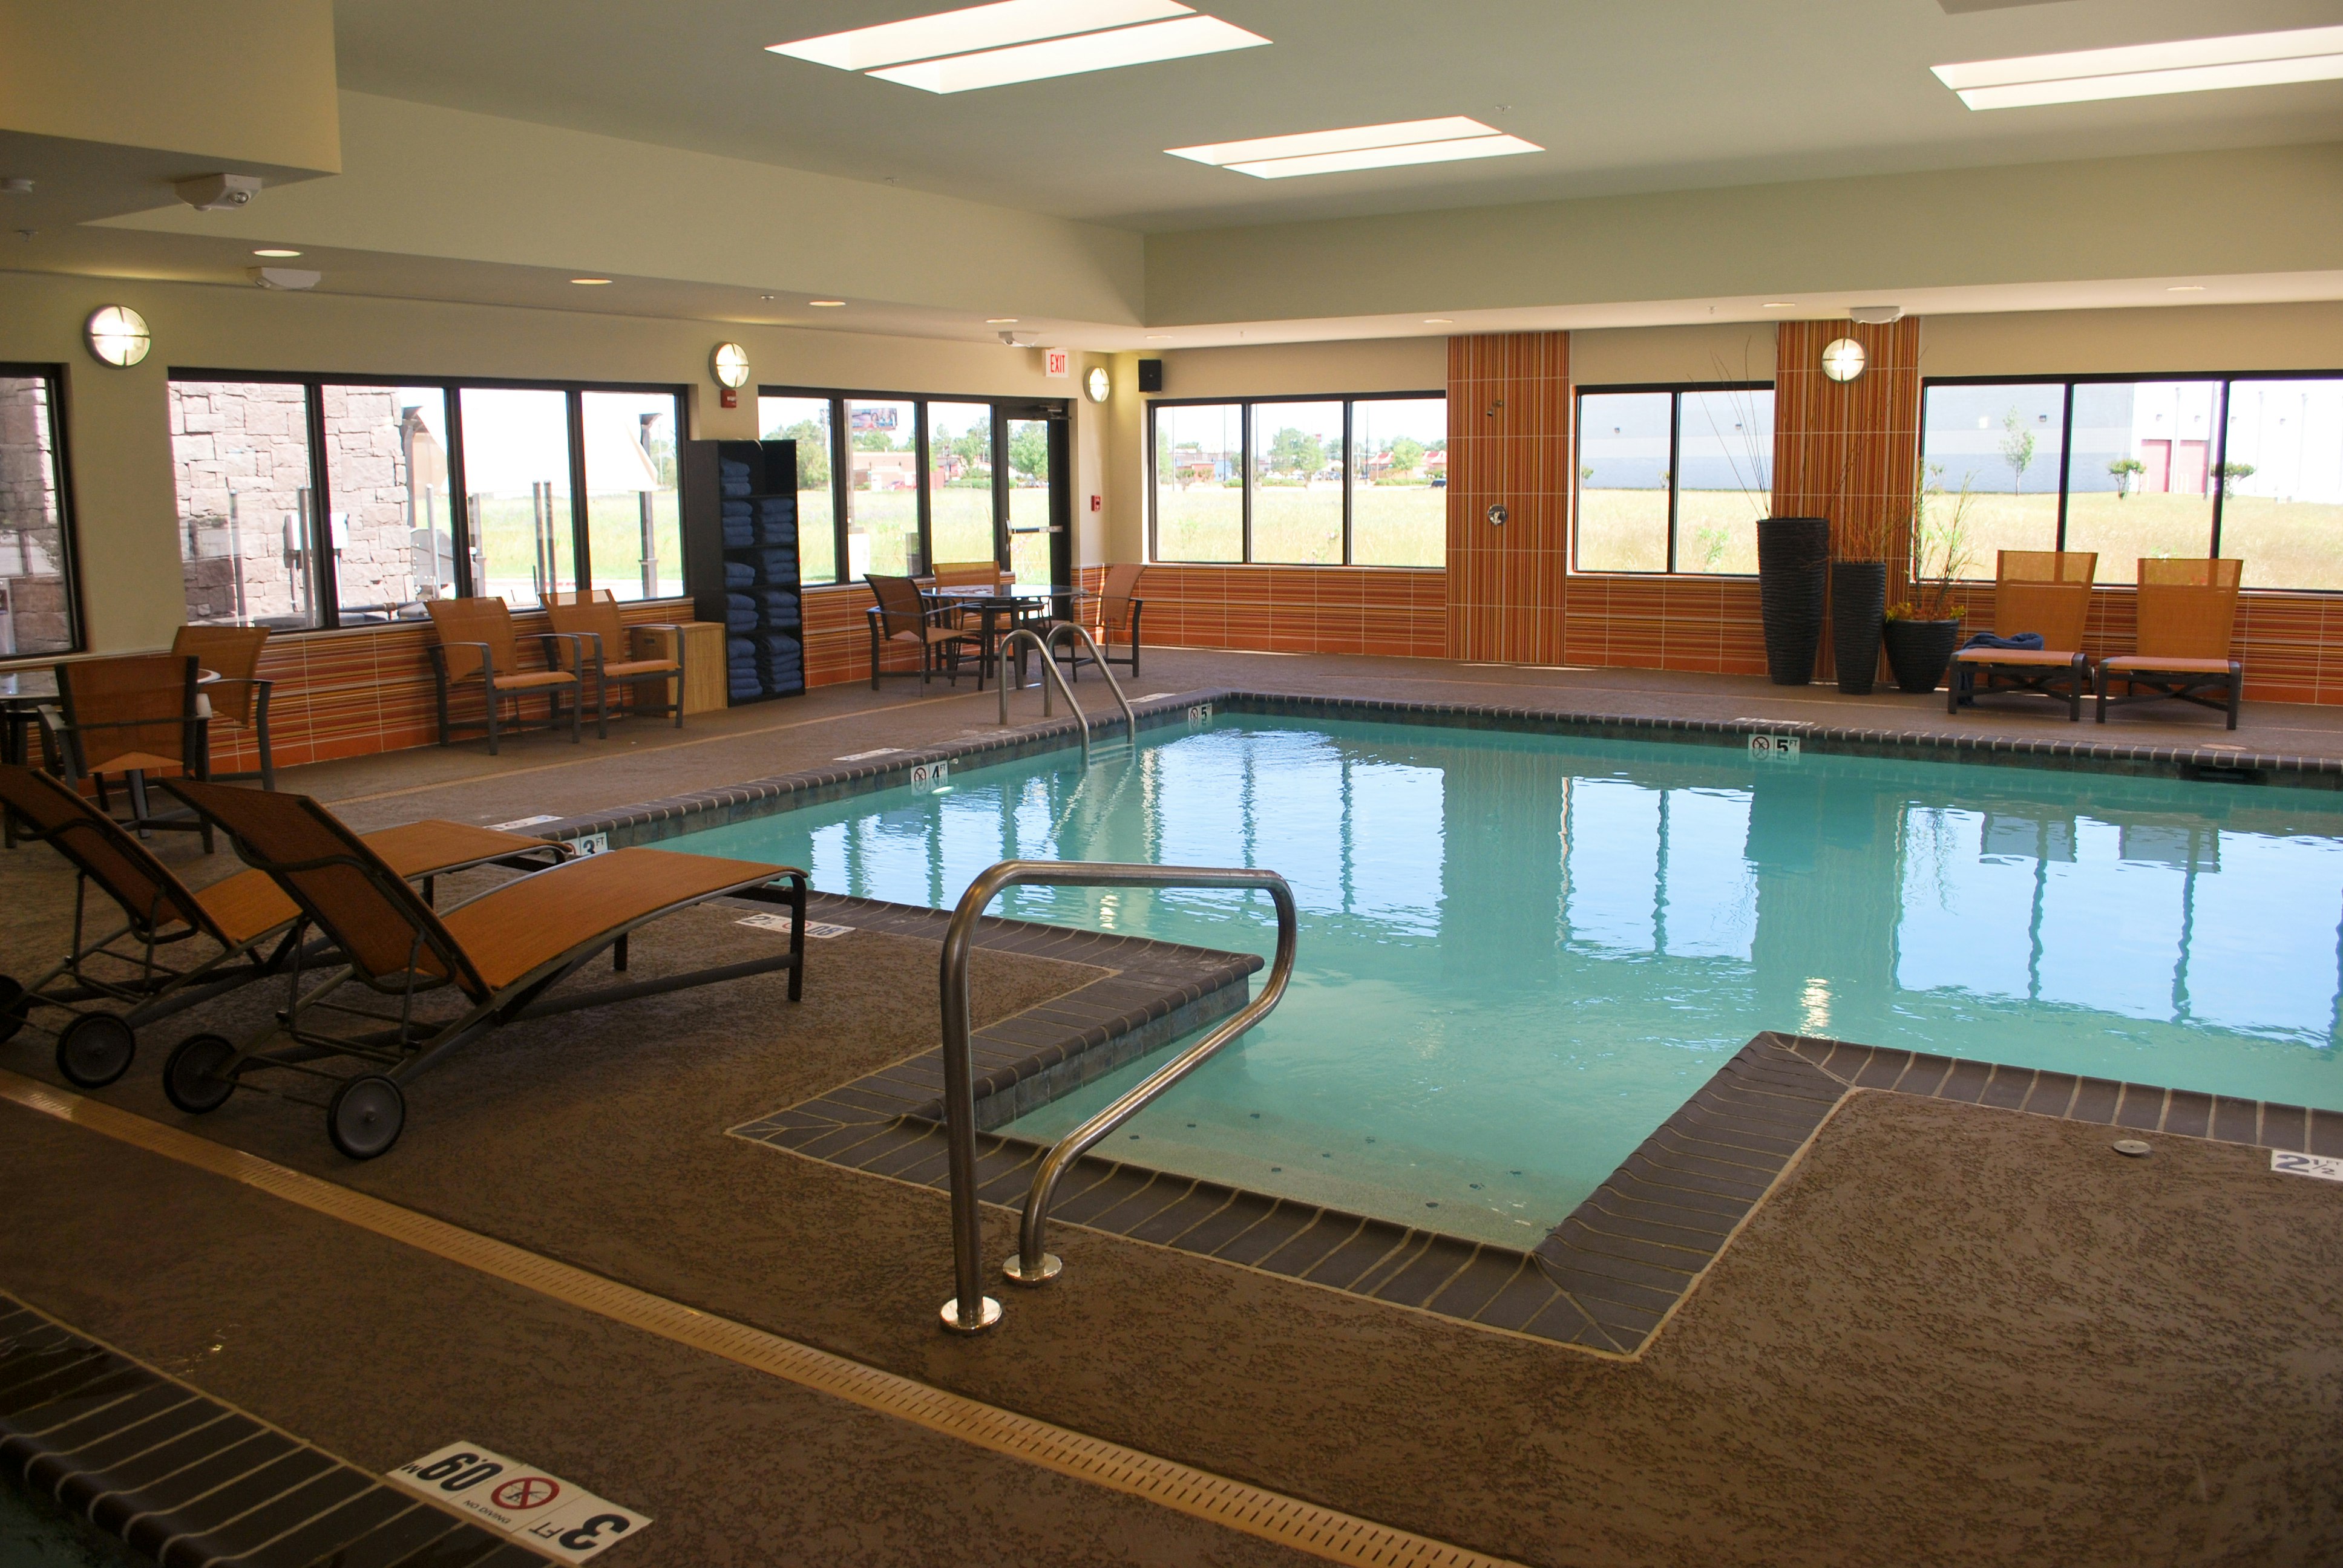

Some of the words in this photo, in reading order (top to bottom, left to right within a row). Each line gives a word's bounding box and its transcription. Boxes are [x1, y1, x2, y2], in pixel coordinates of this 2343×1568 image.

[1050, 354, 1065, 373] EXIT
[1201, 707, 1207, 717] 5
[1777, 739, 1788, 751] 5
[583, 840, 595, 854] 3
[597, 837, 604, 846] FT
[740, 915, 771, 924] 2
[2275, 1154, 2310, 1173] 2
[401, 1463, 422, 1474] M
[417, 1453, 503, 1491] 0.9
[464, 1500, 479, 1509] NO
[480, 1508, 511, 1524] DIVING
[528, 1522, 565, 1538] FT
[559, 1514, 630, 1550] 3
